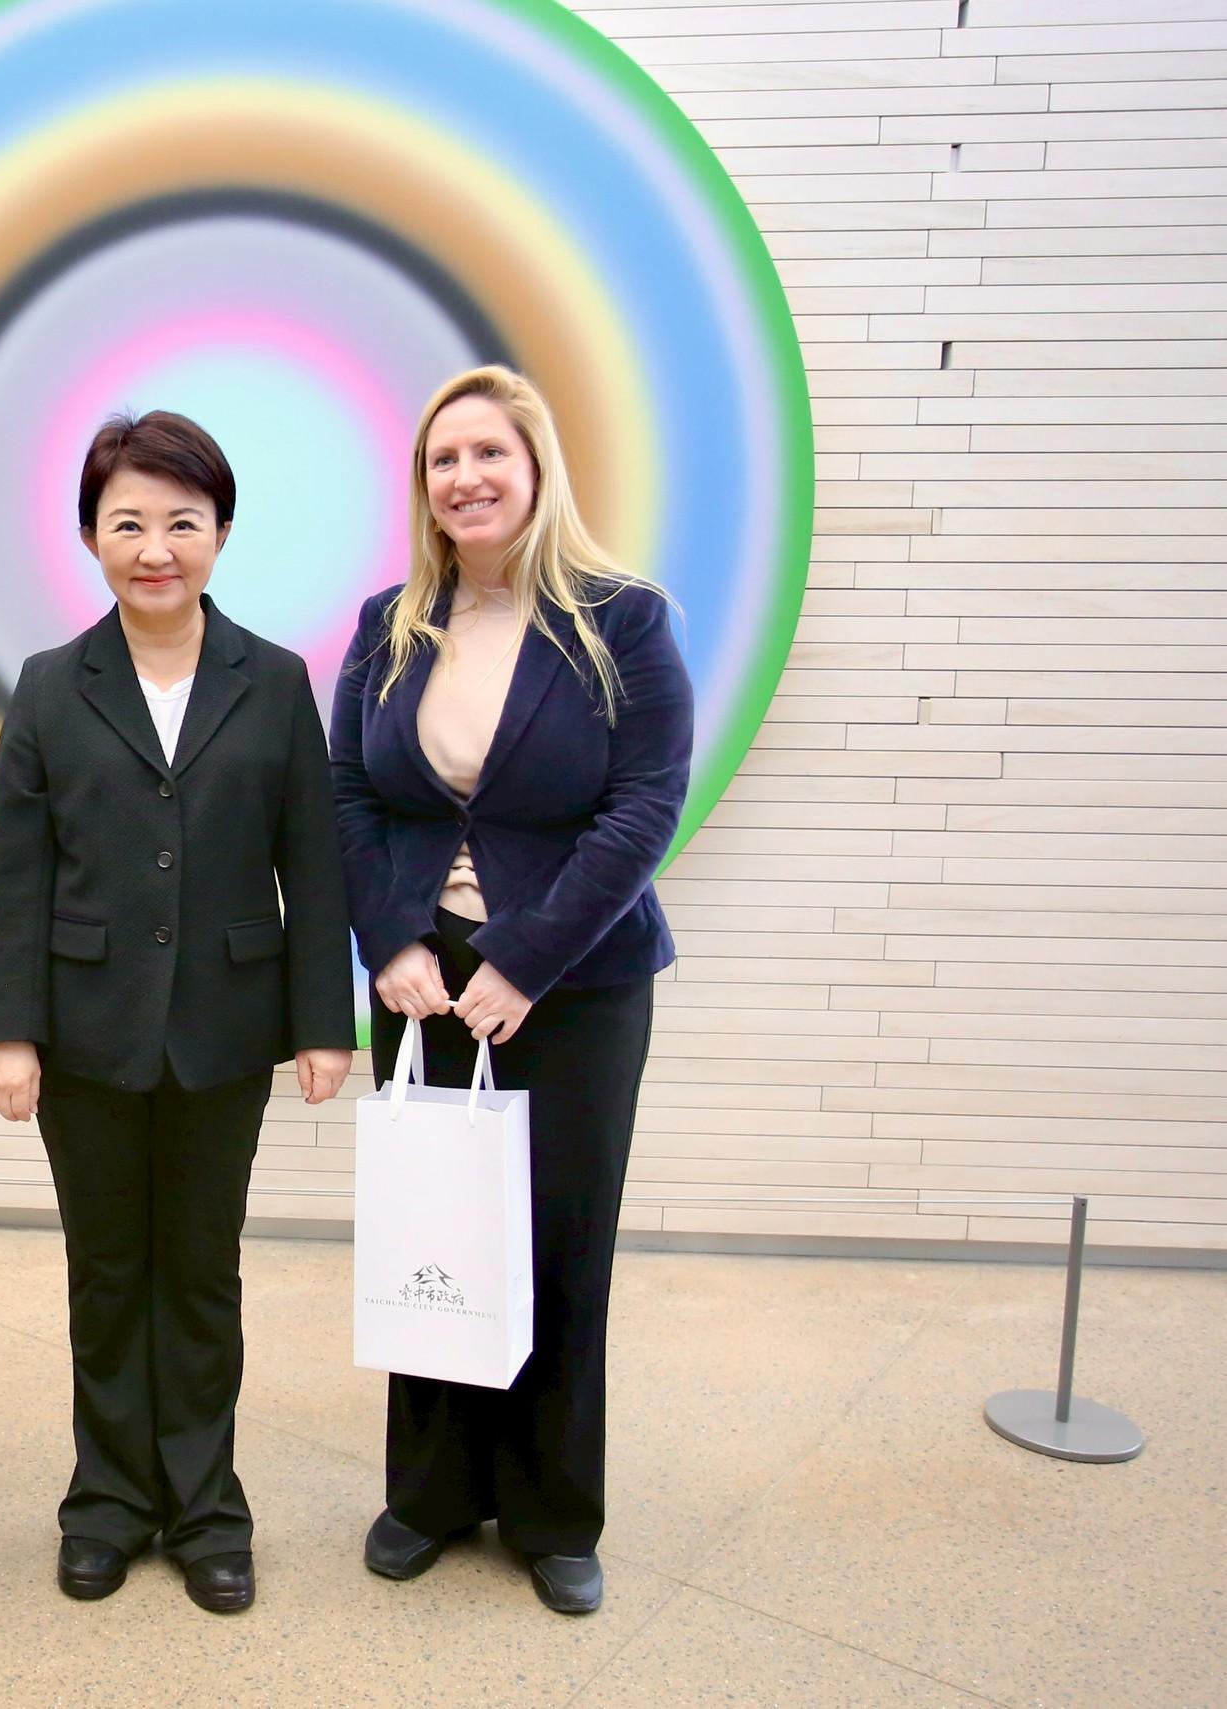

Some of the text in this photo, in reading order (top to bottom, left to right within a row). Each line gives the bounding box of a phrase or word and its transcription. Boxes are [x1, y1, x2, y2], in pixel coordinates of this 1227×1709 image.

[365, 1297, 498, 1320] TAICHUNG CITY GOVERNMENT
